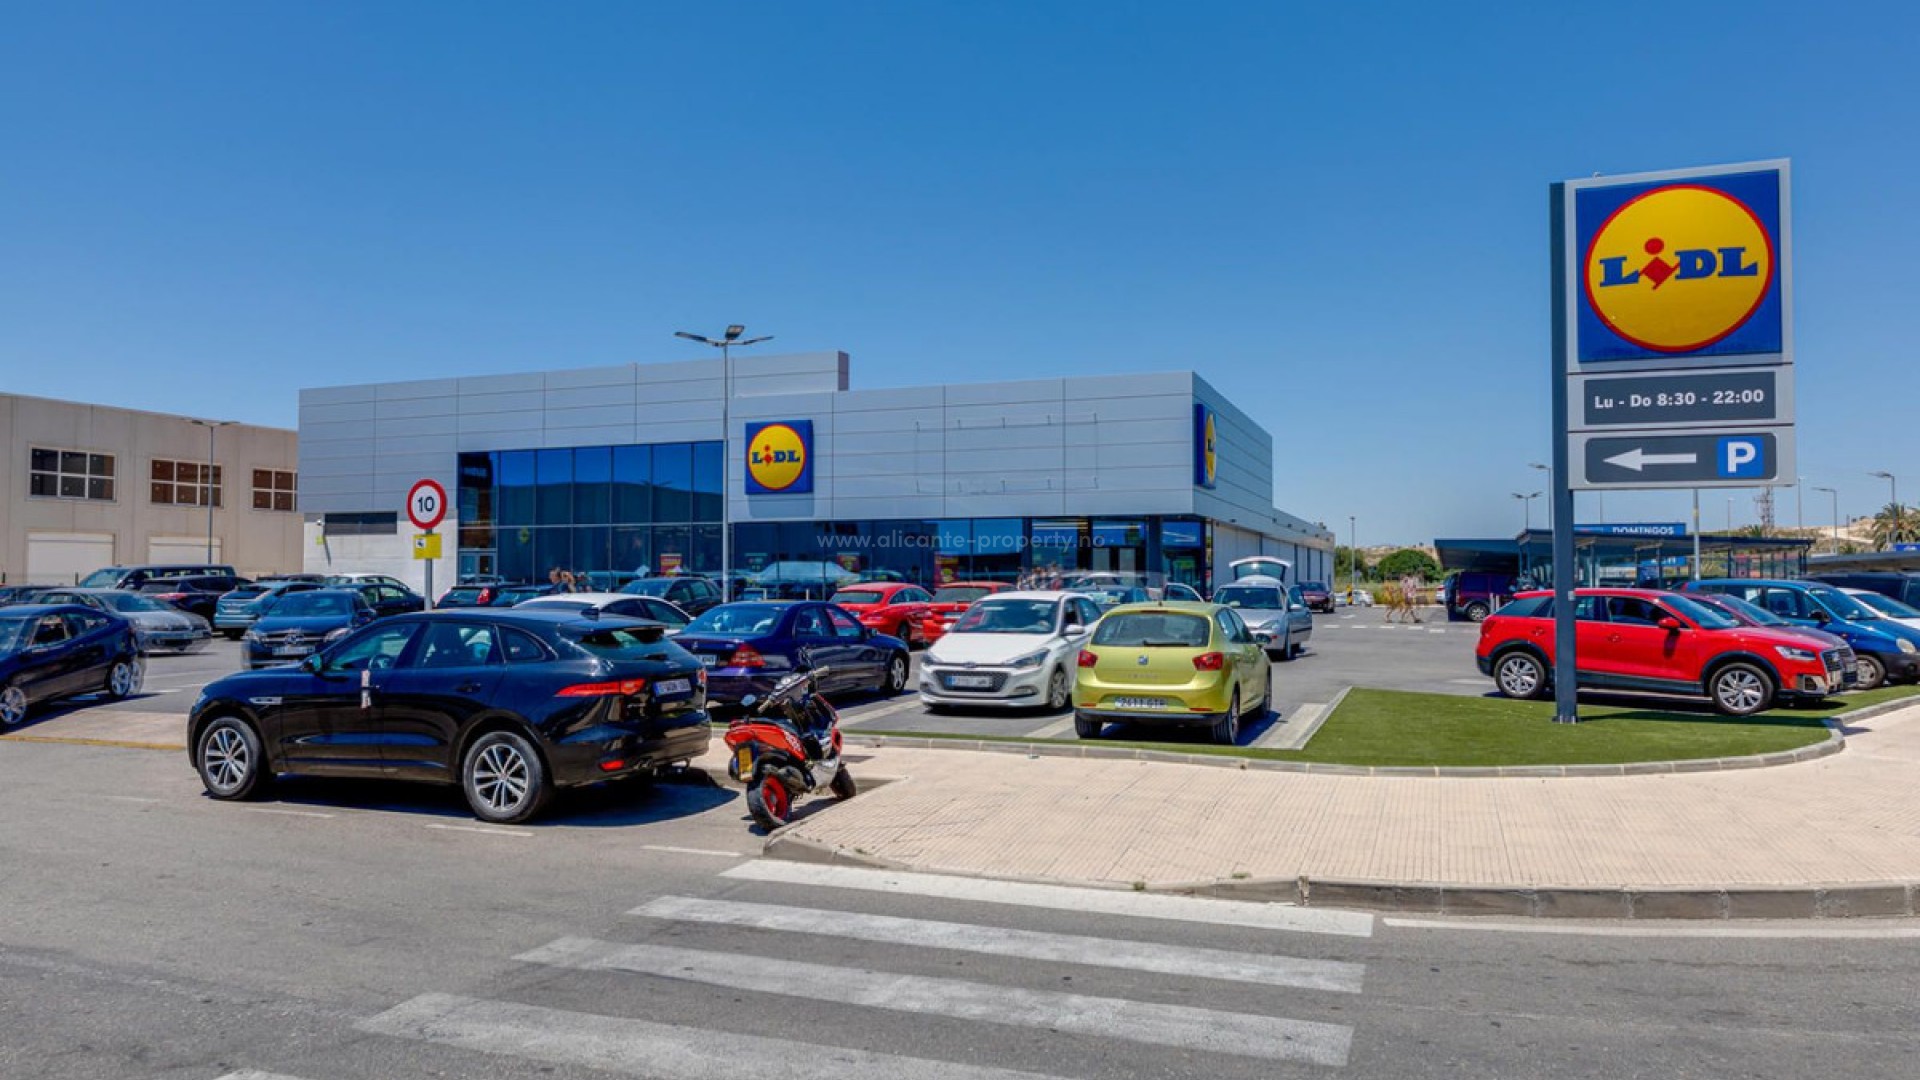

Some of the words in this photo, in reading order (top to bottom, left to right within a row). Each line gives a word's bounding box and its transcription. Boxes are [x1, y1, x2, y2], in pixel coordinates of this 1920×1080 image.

[1594, 396, 1613, 409] Lu
[1630, 394, 1652, 407] Do
[1657, 392, 1696, 407] 8:30
[1713, 389, 1764, 405] 22:00
[1727, 441, 1756, 474] P
[417, 496, 435, 513] 10
